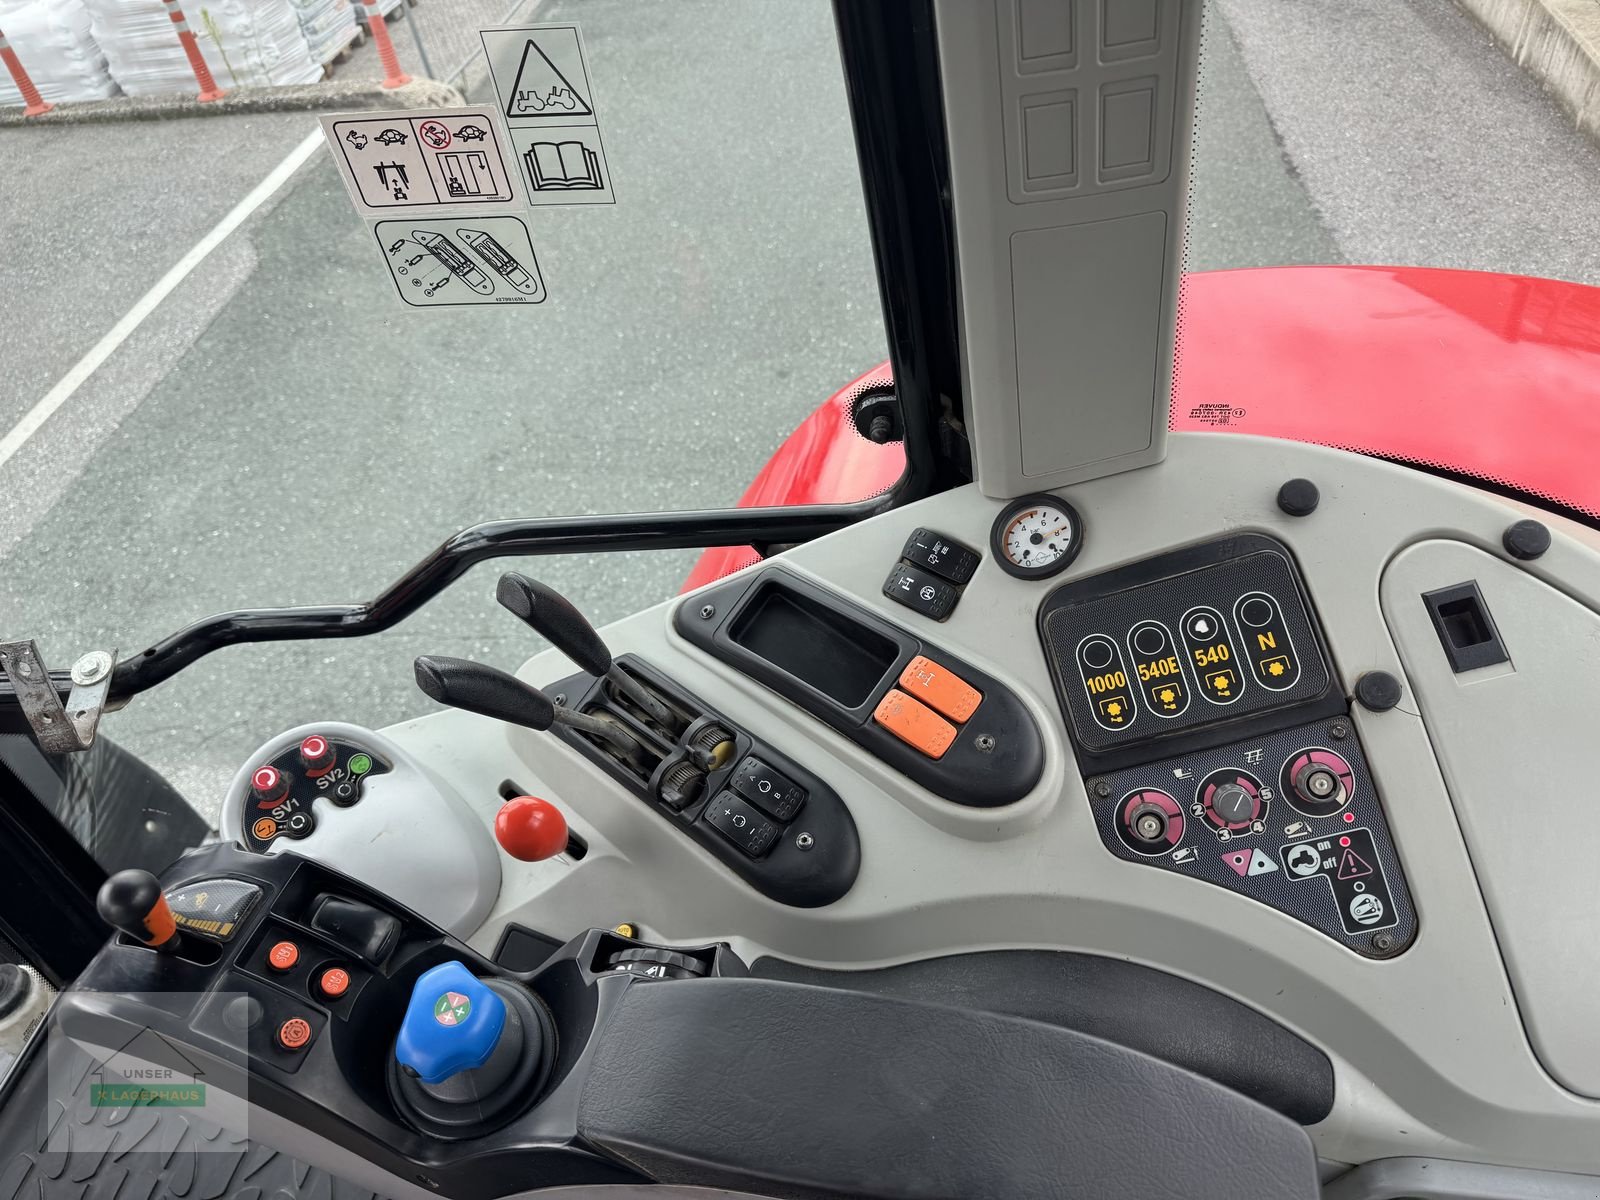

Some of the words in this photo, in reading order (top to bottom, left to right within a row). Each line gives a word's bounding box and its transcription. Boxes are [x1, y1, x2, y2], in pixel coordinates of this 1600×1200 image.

[1257, 632, 1277, 651] N
[1194, 643, 1230, 667] 540
[1137, 656, 1180, 681] 540E
[1087, 670, 1126, 695] 1000
[316, 768, 345, 790] SV2
[1261, 789, 1272, 799] 5
[271, 797, 300, 820] SV1
[1193, 805, 1203, 815] 2
[1219, 830, 1230, 840] 3
[1253, 822, 1263, 832] 4
[1316, 840, 1332, 851] on
[1322, 856, 1338, 870] off
